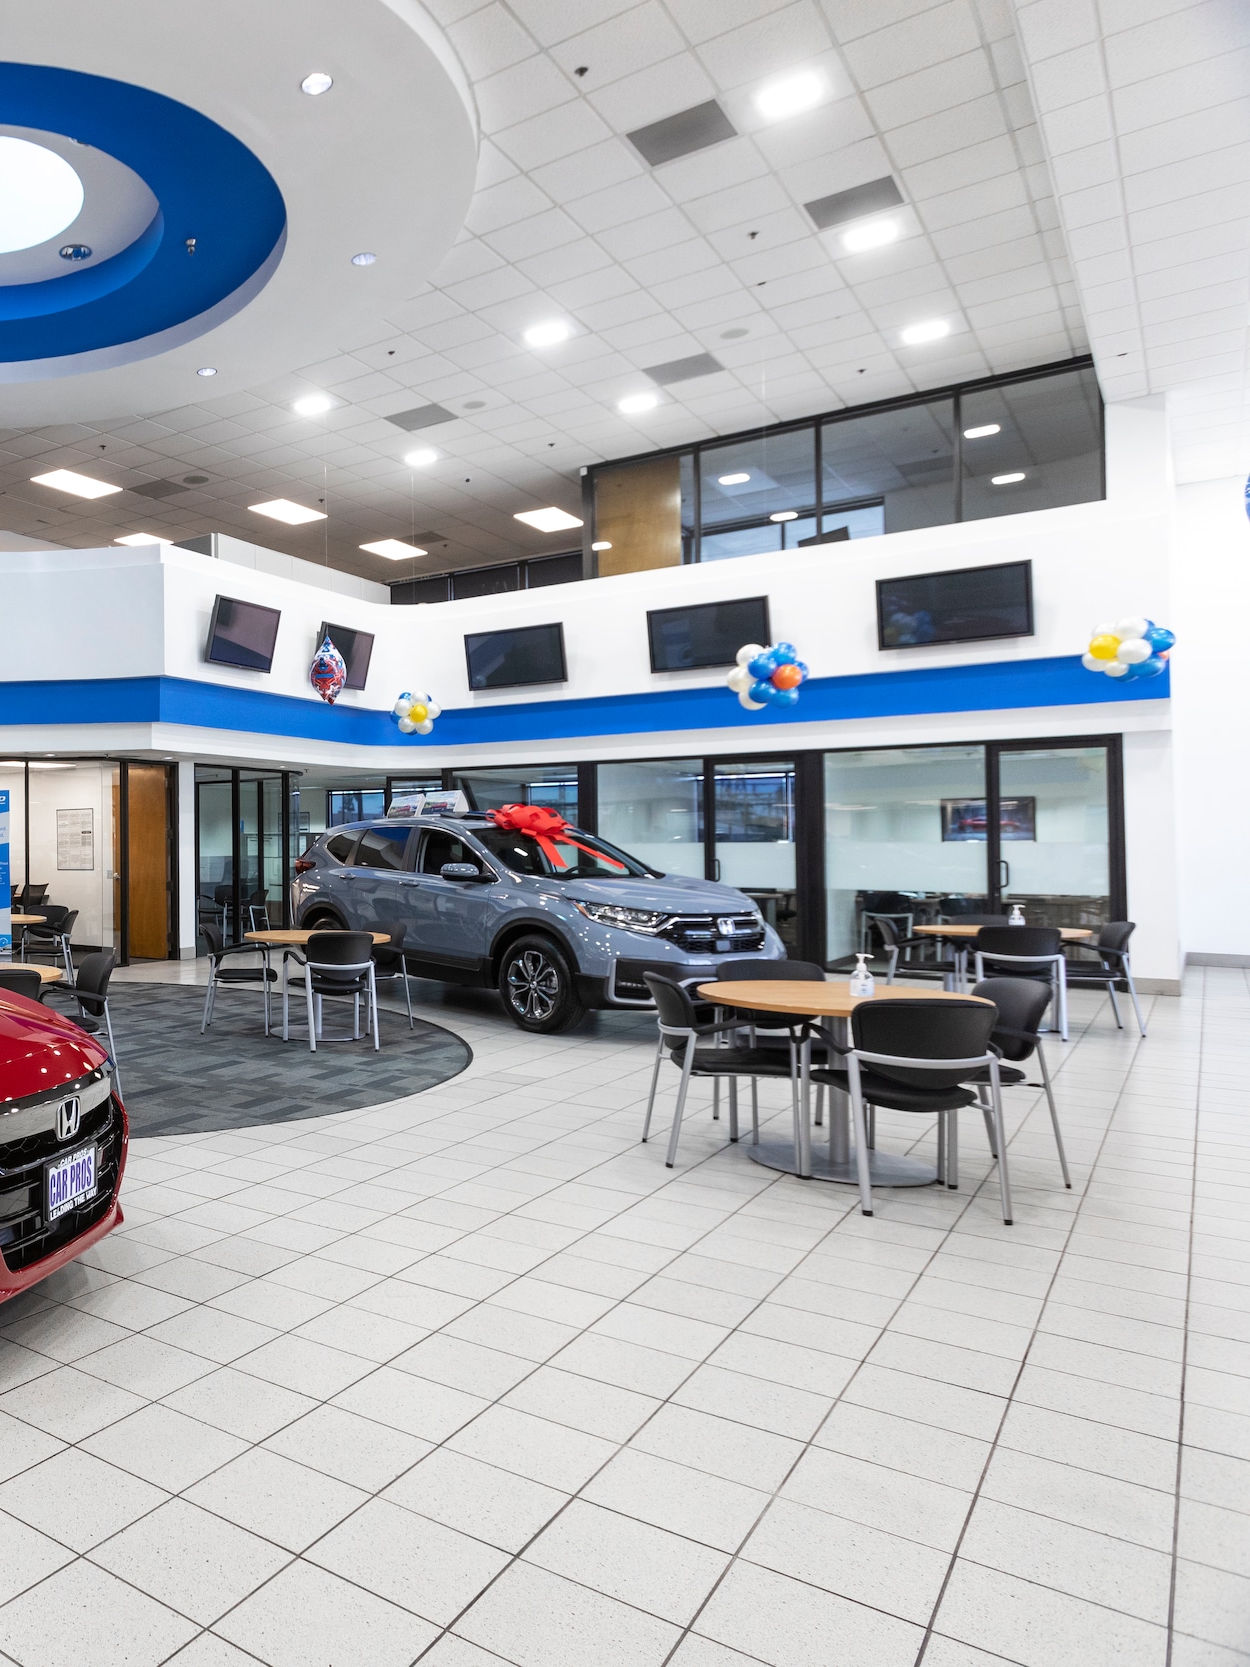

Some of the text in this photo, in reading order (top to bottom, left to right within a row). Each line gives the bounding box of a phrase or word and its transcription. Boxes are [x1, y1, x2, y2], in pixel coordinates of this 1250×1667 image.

[60, 1148, 88, 1167] CAR PROS
[50, 1155, 92, 1207] CAR PROS
[50, 1200, 74, 1222] LEADING
[73, 1194, 86, 1207] THE
